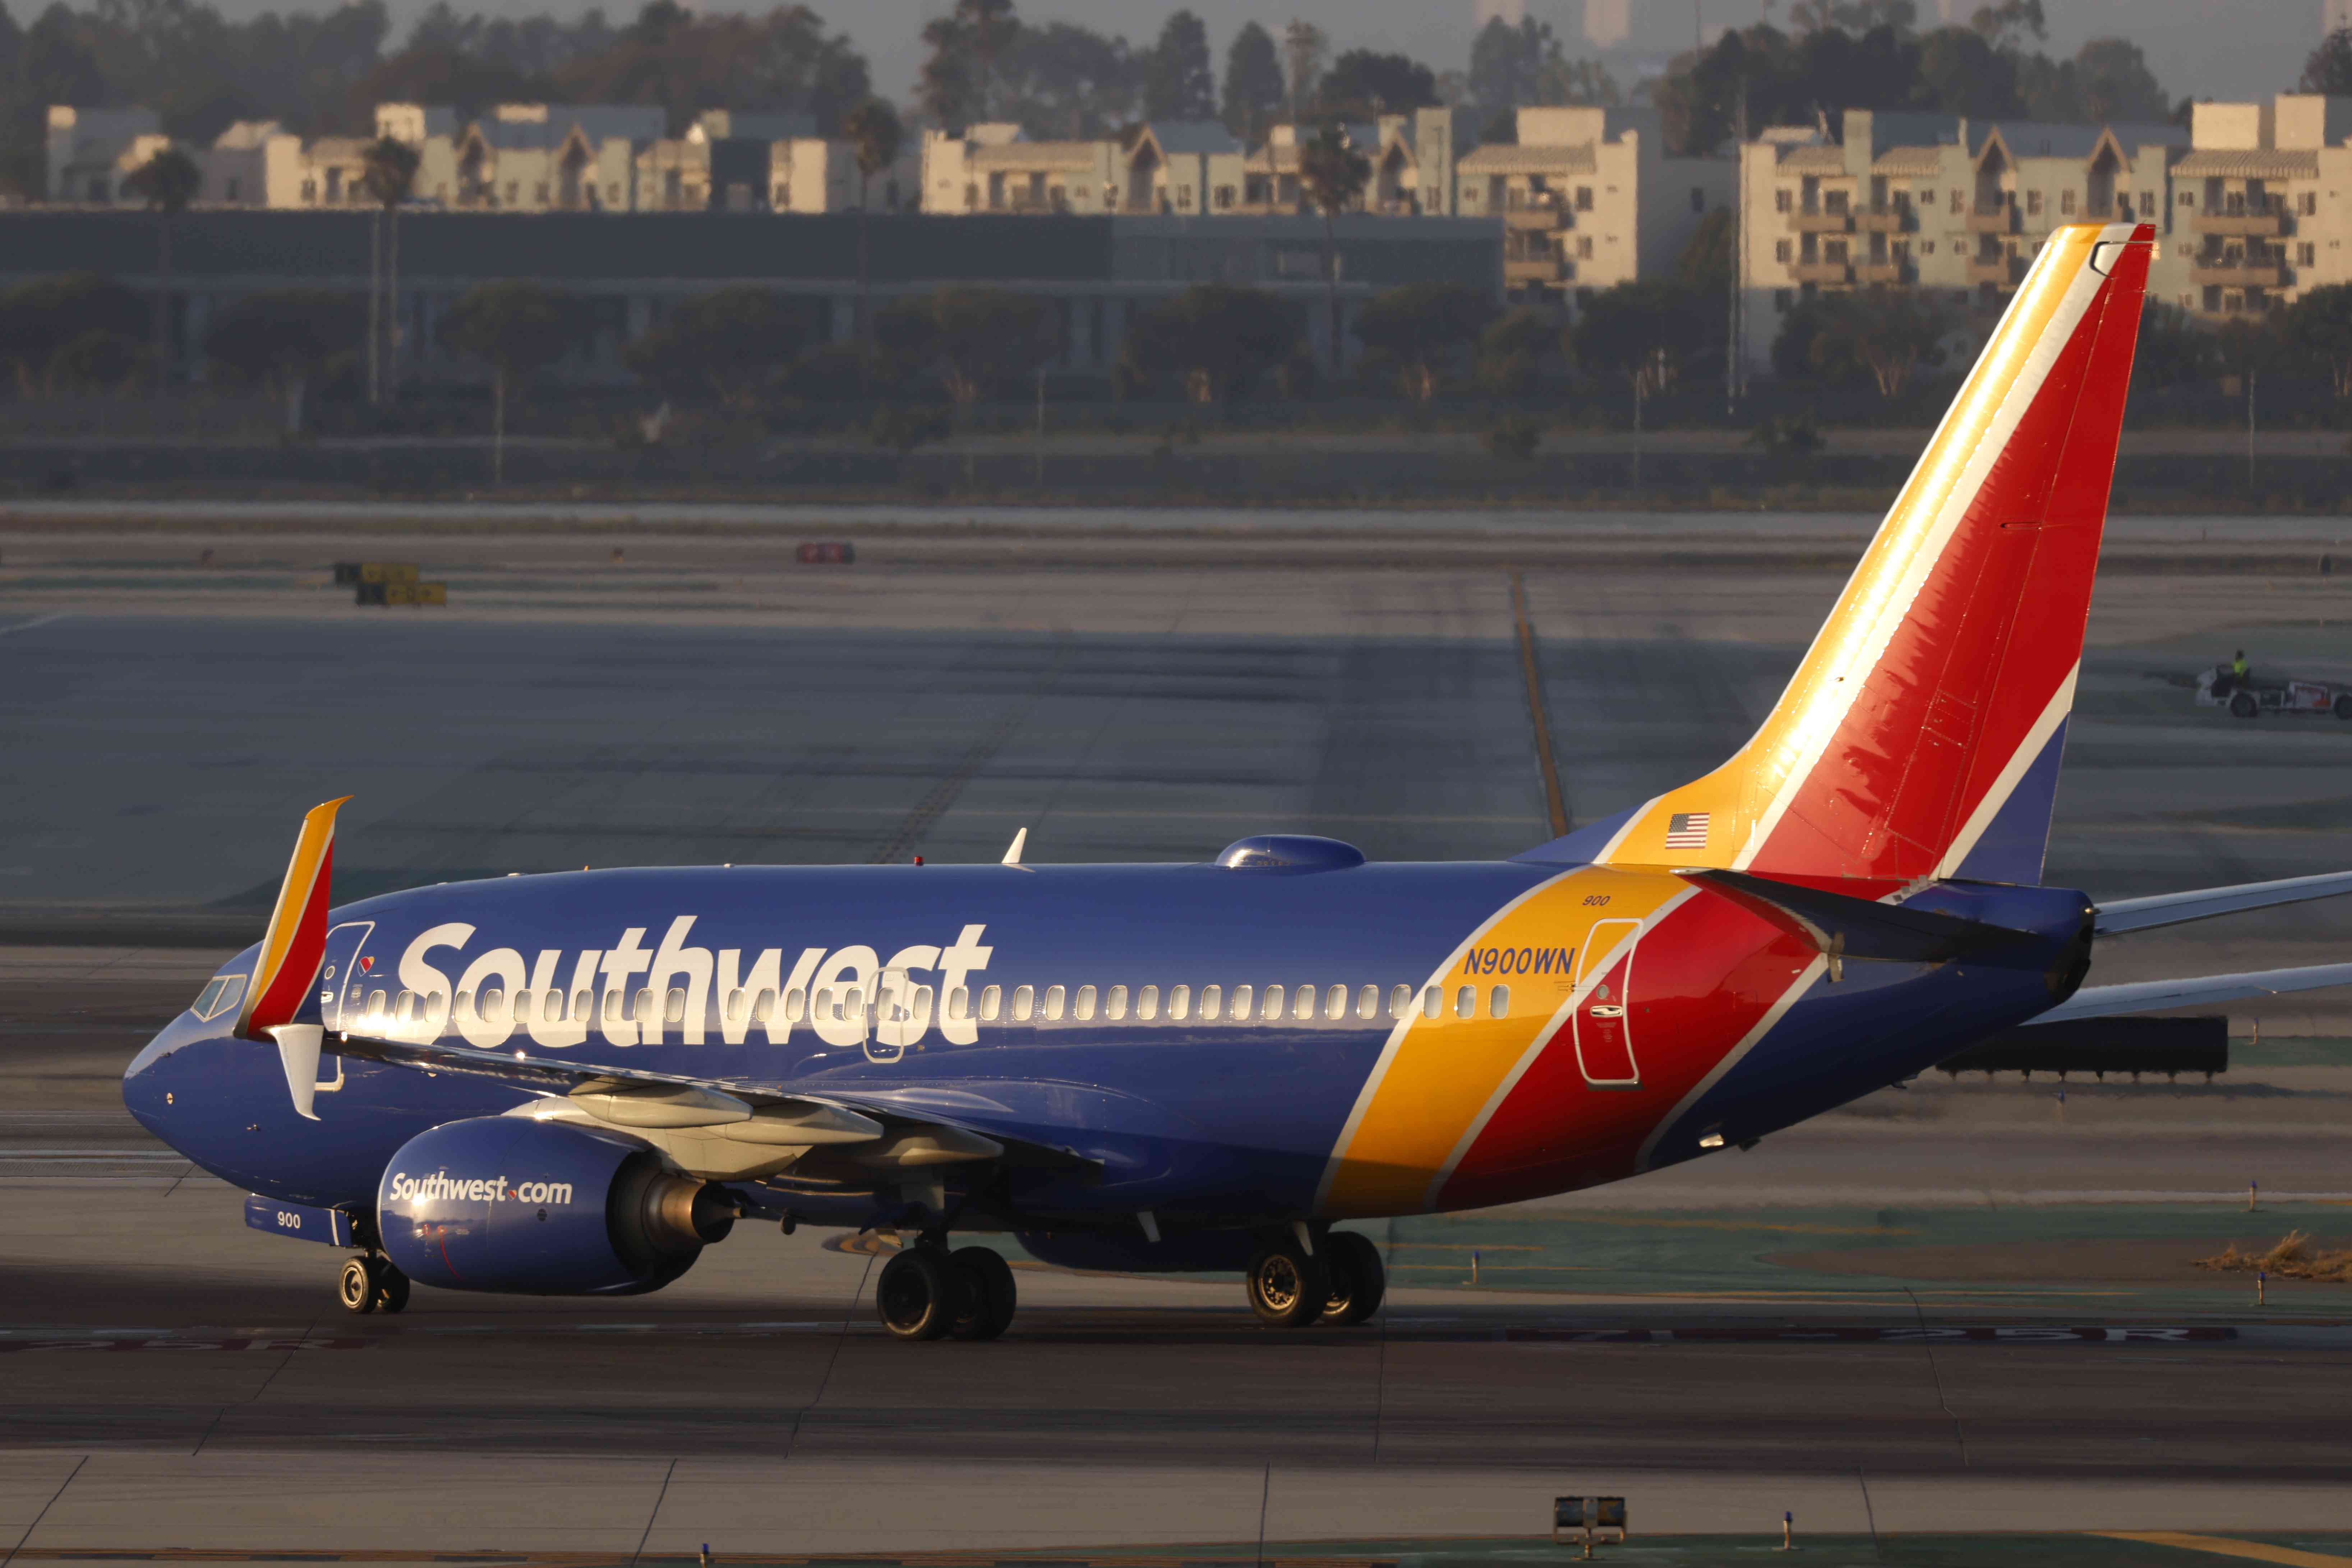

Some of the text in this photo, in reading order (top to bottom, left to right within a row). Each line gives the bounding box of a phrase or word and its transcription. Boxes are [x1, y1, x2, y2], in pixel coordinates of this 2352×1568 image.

[1582, 895, 1610, 906] 900
[1463, 947, 1576, 975] N900WN
[398, 915, 995, 1048] Southwest
[277, 1211, 301, 1229] 900
